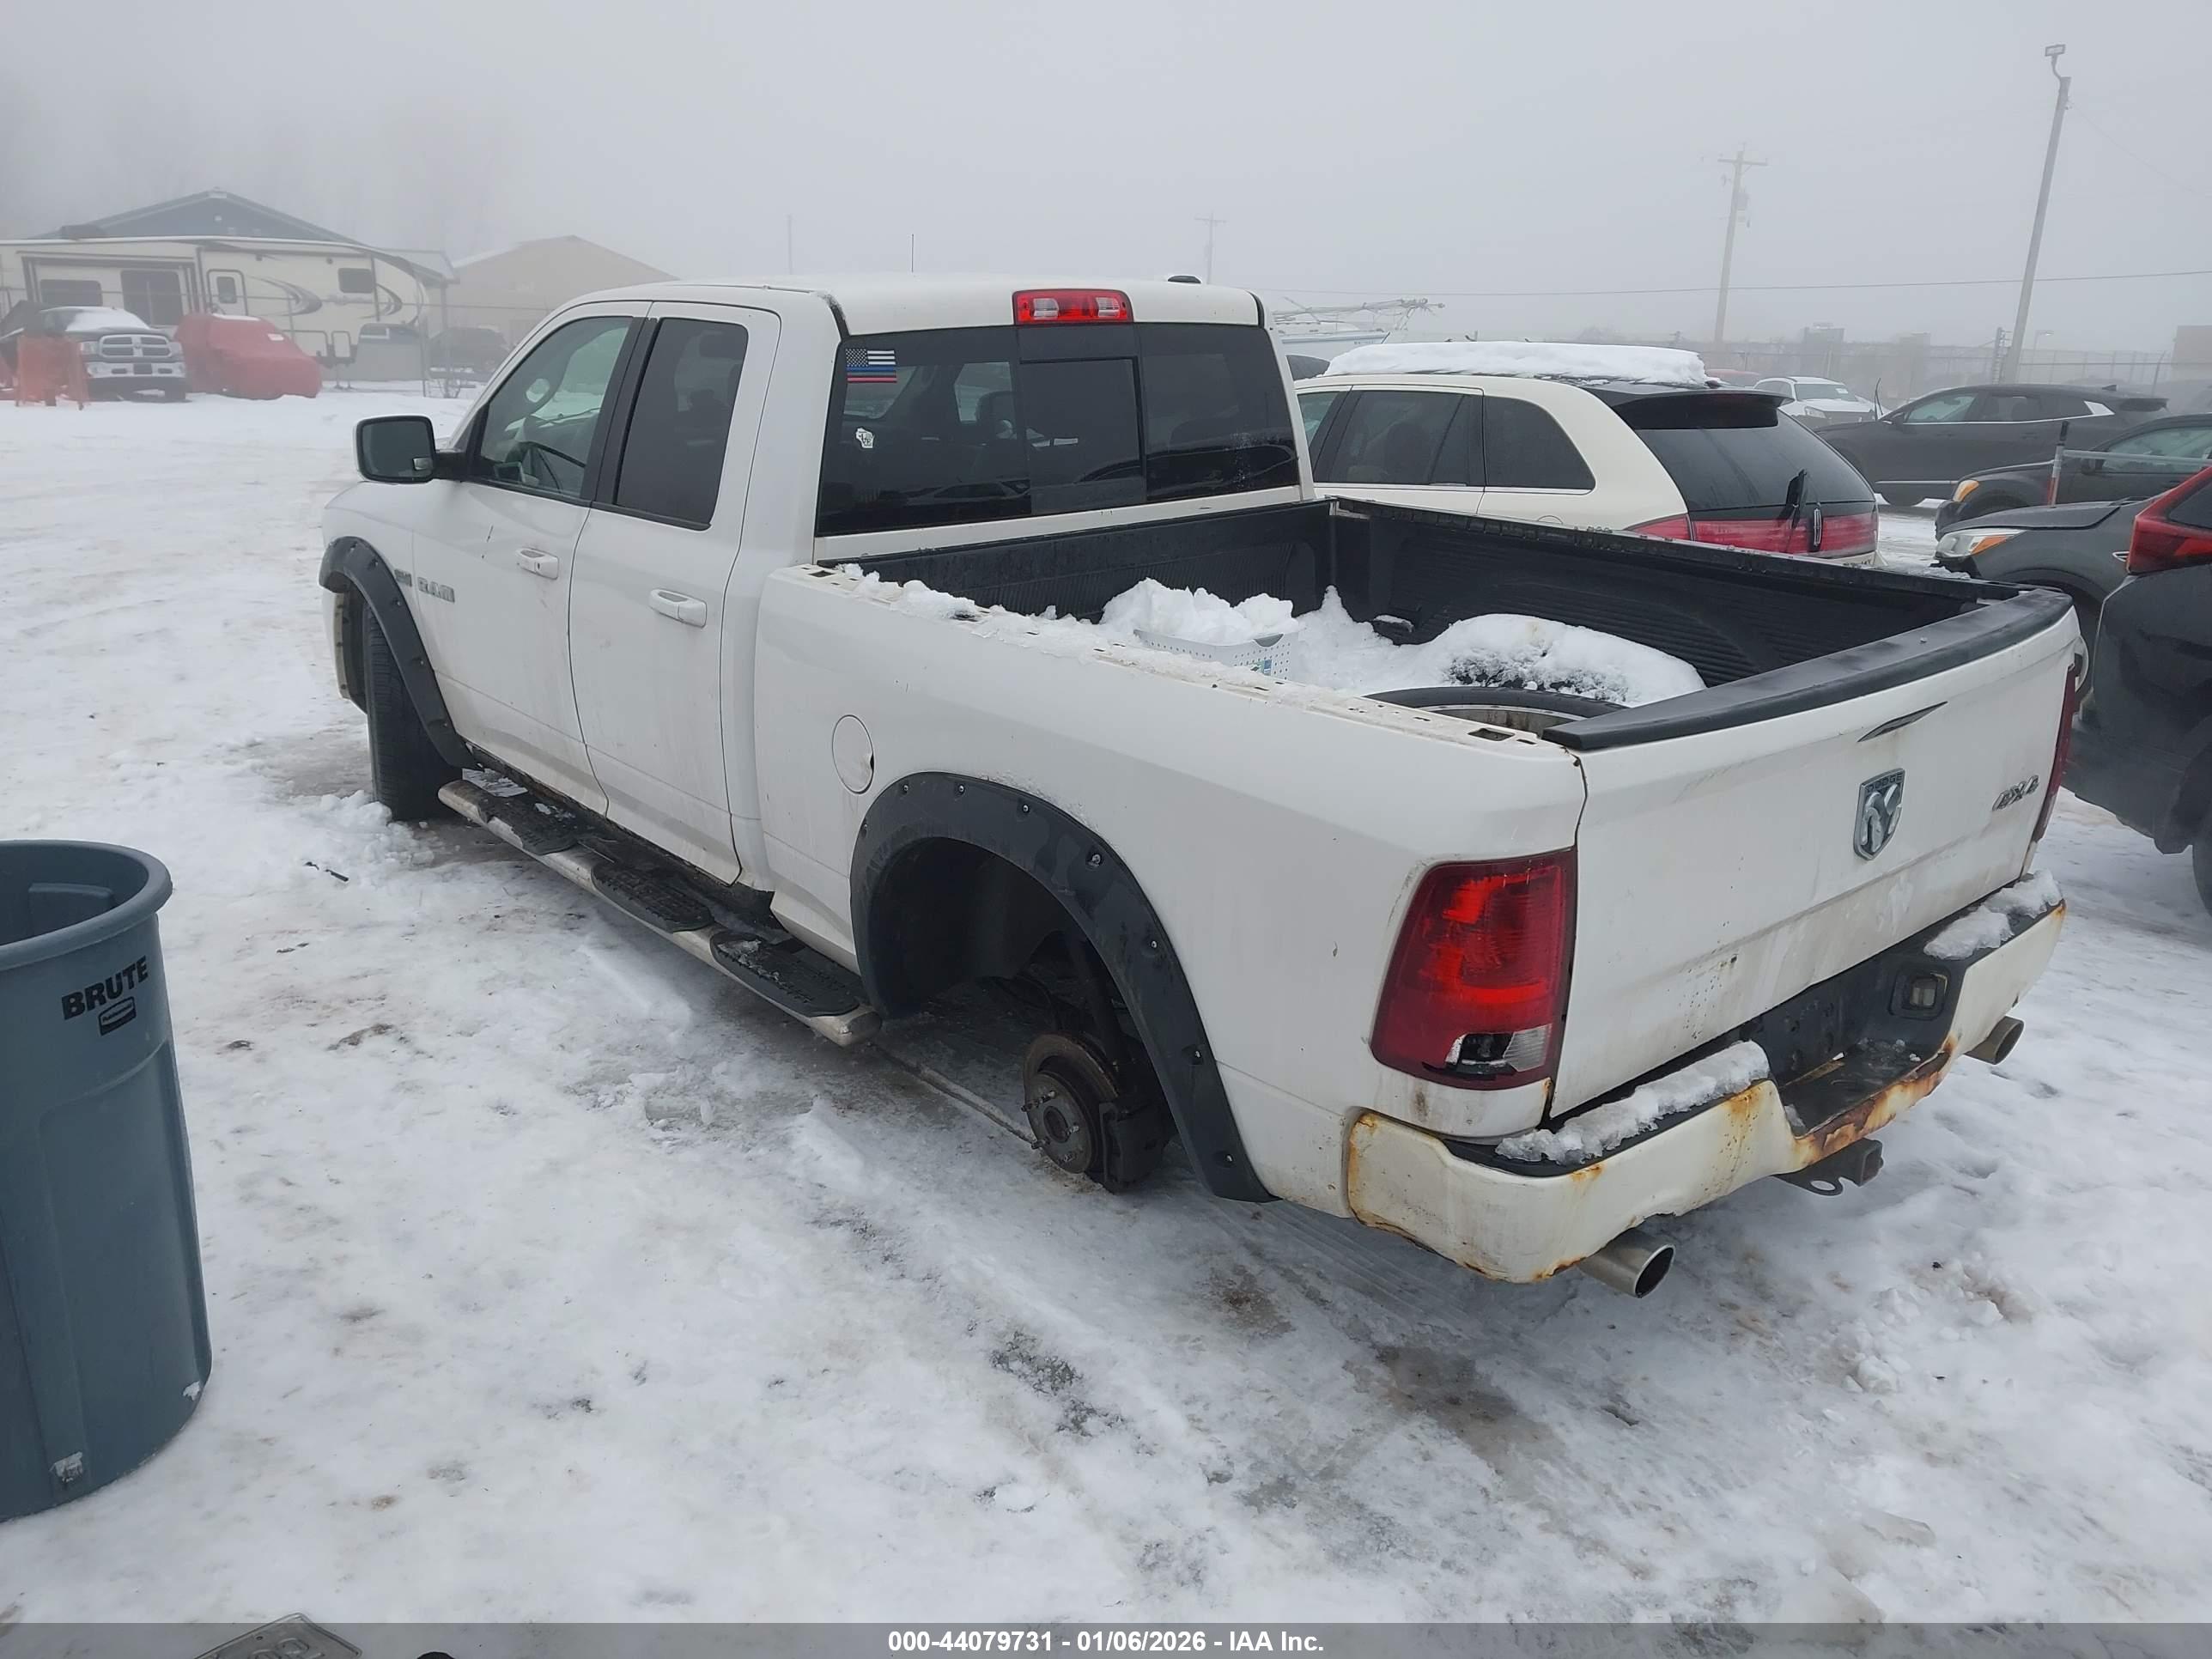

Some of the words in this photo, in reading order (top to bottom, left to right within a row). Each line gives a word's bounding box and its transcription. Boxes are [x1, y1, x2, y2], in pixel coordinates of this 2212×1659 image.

[417, 576, 456, 604] RAM
[1864, 771, 1904, 794] DODGE
[61, 955, 149, 1021] BRUTE
